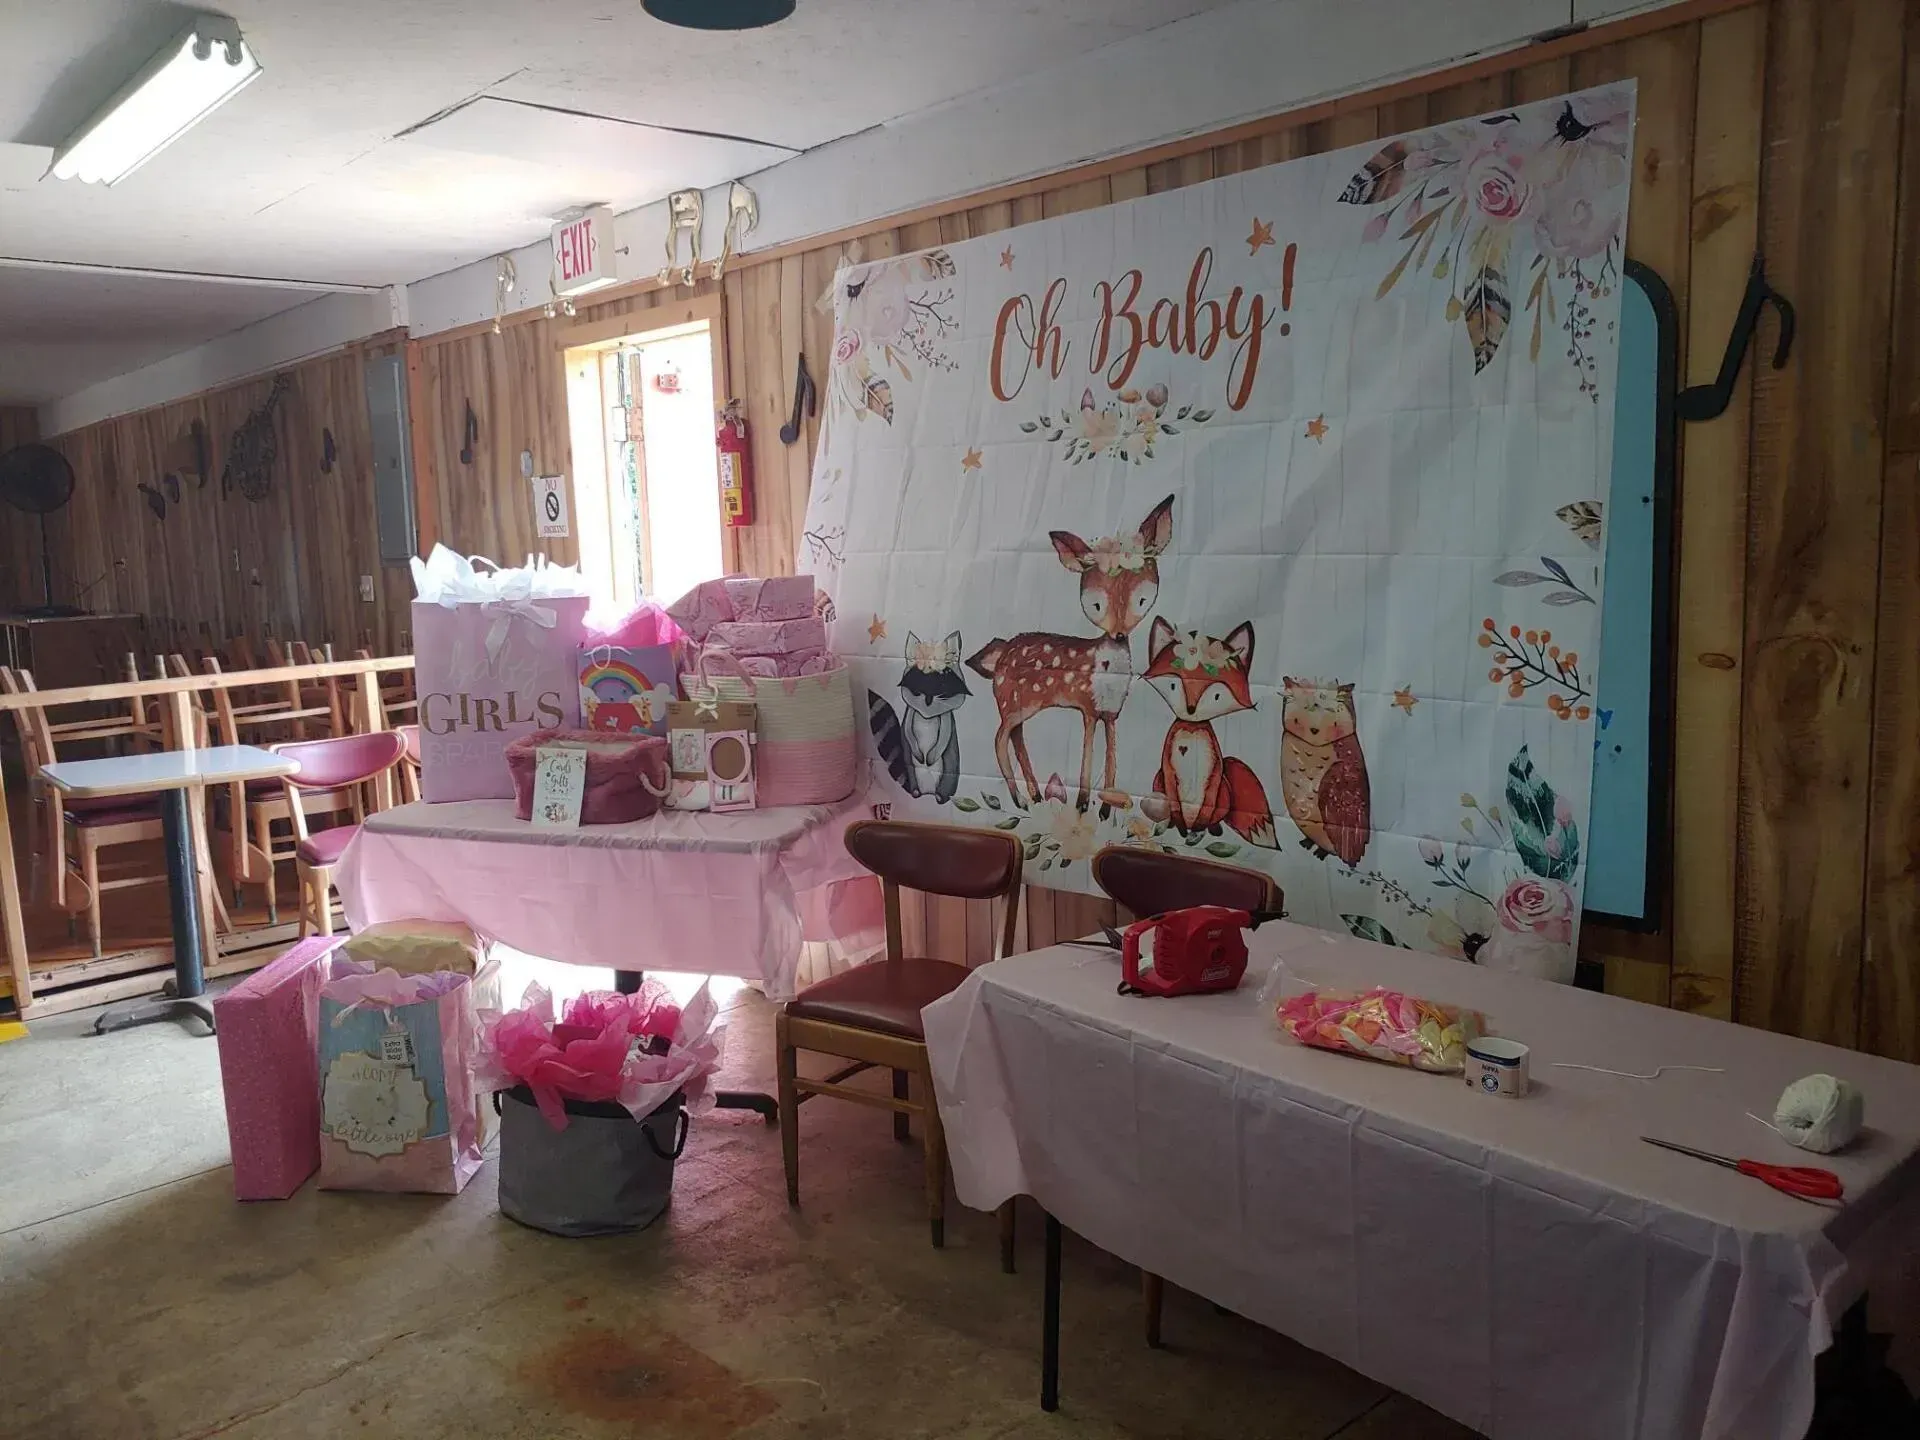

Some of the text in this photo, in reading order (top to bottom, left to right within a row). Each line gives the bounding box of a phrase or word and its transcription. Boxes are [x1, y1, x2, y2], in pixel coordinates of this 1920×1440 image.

[560, 219, 593, 280] EXIT
[990, 243, 1298, 412] Oh Baby!
[545, 479, 557, 491] NO
[543, 525, 567, 534] SMOKING
[420, 691, 565, 735] GIRLS
